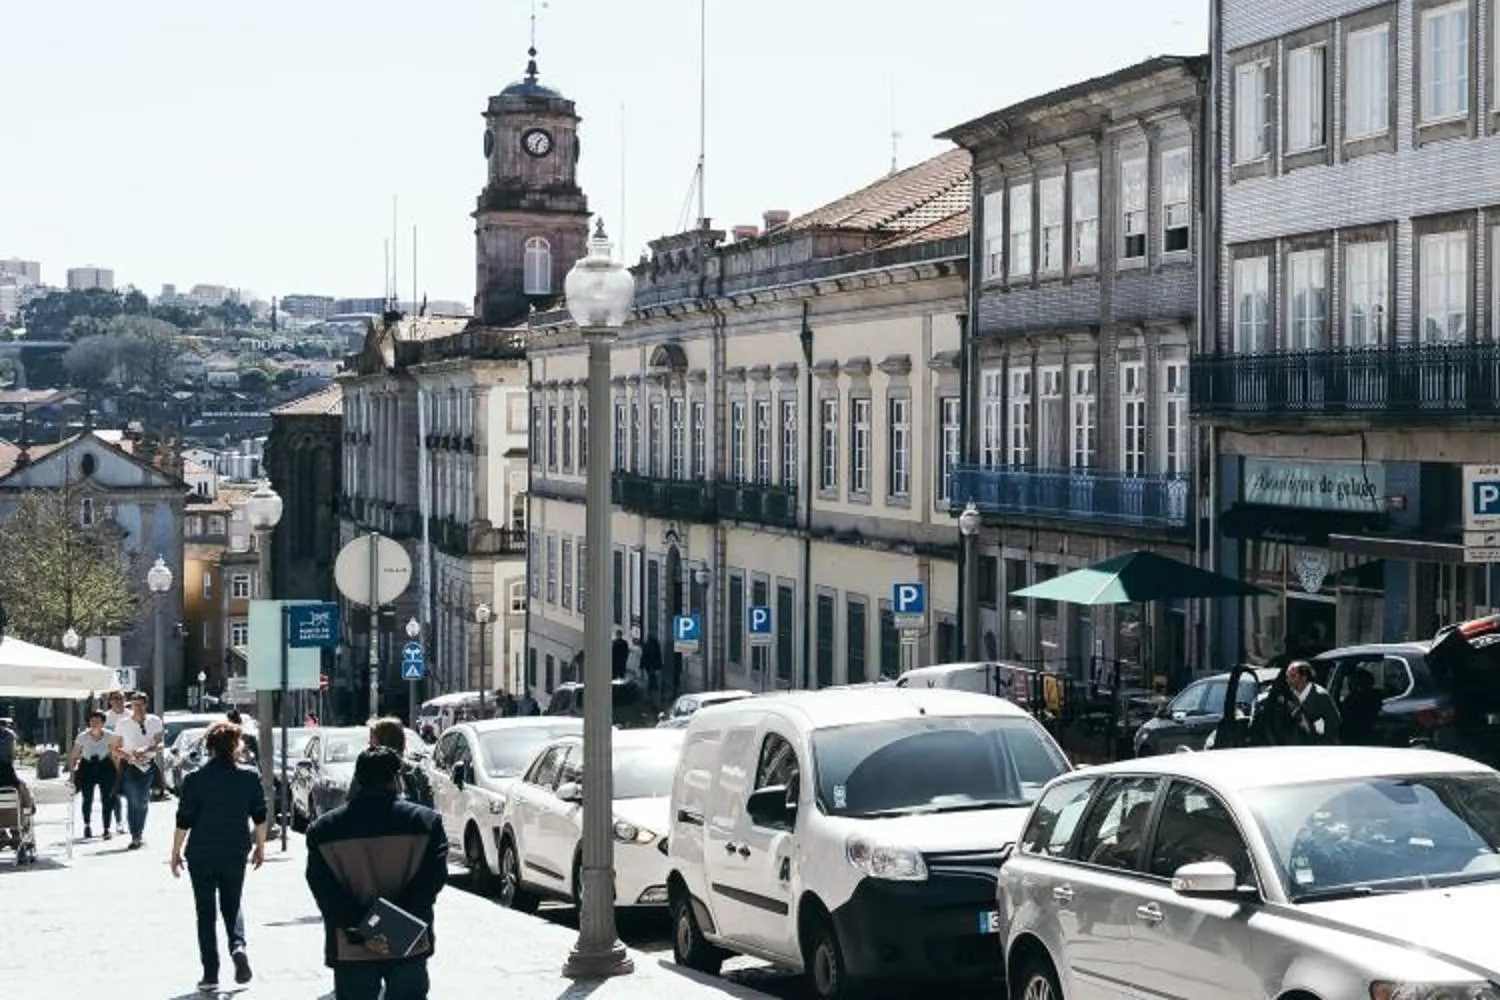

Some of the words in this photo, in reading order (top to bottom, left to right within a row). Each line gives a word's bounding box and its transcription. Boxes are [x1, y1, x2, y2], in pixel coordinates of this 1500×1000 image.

[1479, 485, 1500, 513] P
[899, 586, 917, 612] P
[679, 617, 694, 638] P
[753, 609, 767, 630] P
